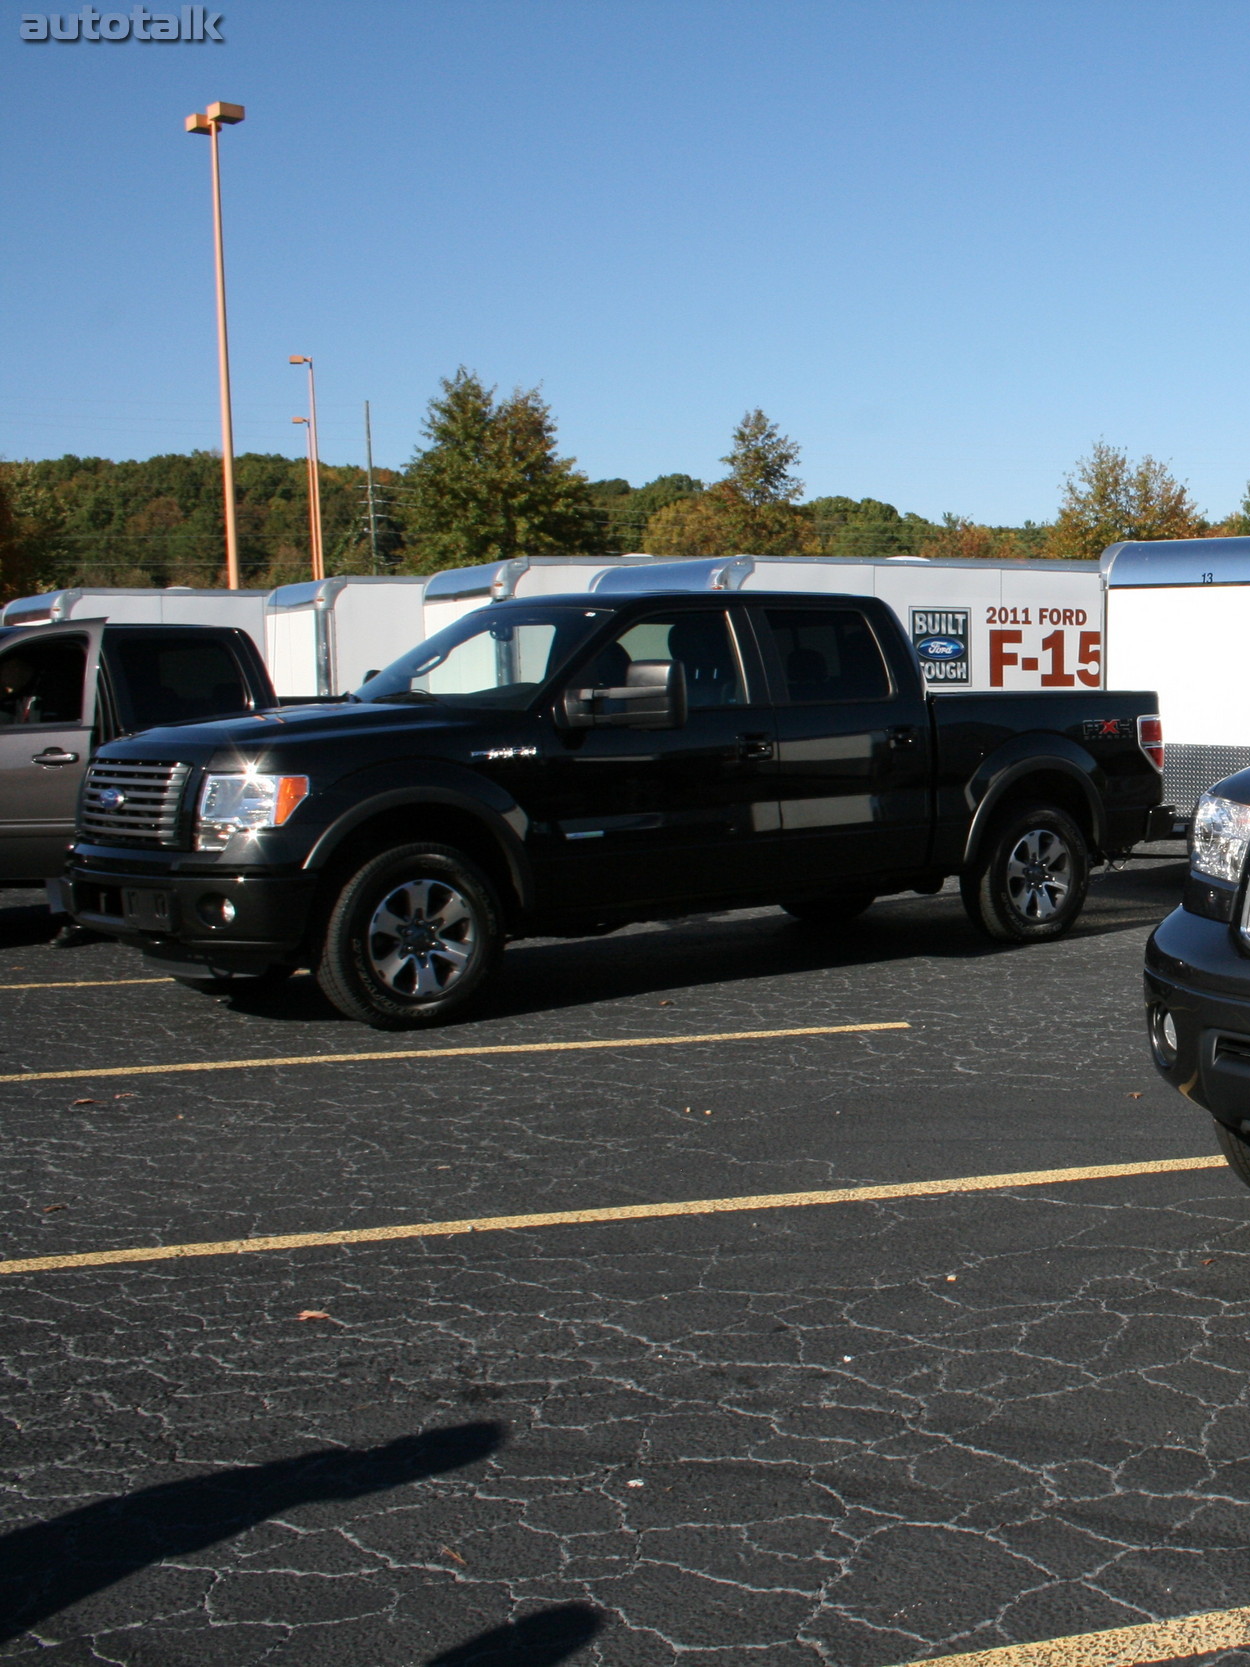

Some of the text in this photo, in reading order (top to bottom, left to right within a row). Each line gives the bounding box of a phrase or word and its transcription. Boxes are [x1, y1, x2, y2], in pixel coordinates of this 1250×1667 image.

[1201, 572, 1213, 584] 13
[914, 612, 967, 636] BUILT
[986, 606, 1088, 626] 2011 FORD
[928, 640, 954, 654] Ford
[989, 629, 1101, 688] F-15
[920, 661, 967, 680] OUGH
